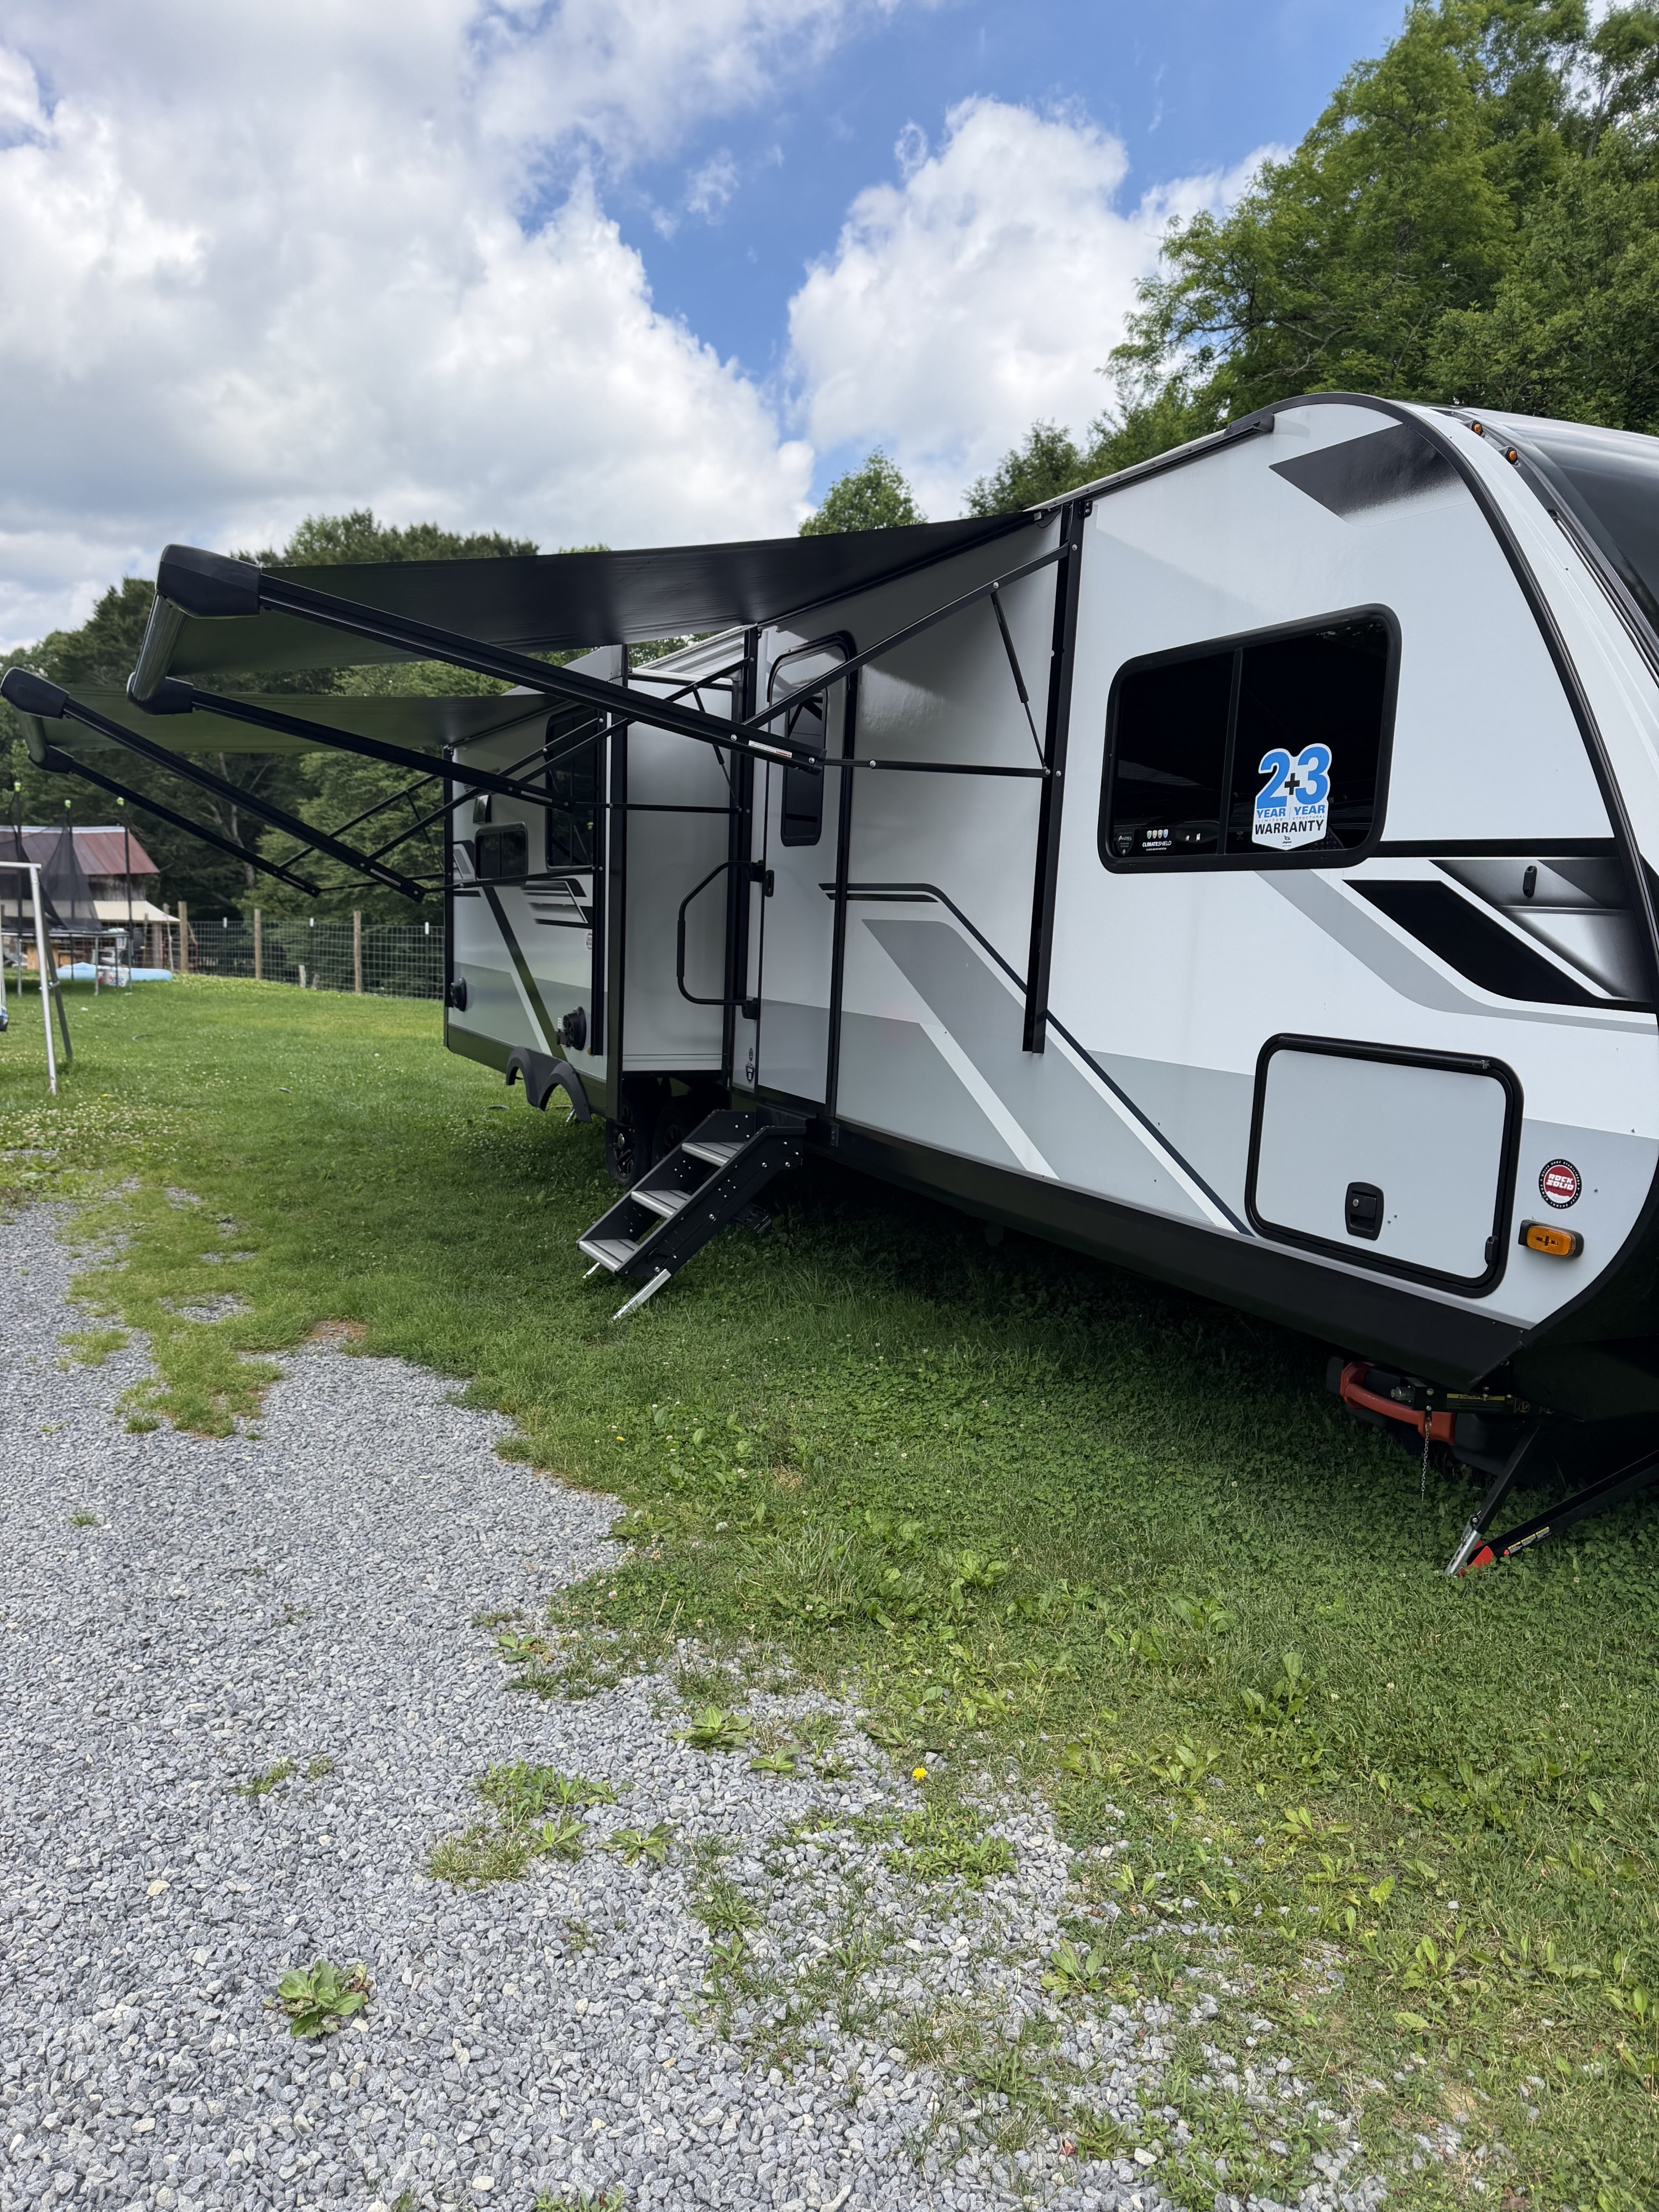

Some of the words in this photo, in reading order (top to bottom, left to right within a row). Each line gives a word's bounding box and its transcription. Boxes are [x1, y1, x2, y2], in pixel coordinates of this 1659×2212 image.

[1256, 808, 1286, 818] YEAR
[1294, 805, 1326, 816] YEAR
[1255, 819, 1324, 835] WARRANTY
[1548, 1173, 1574, 1184] ROCK
[1546, 1179, 1574, 1191] SOLID
